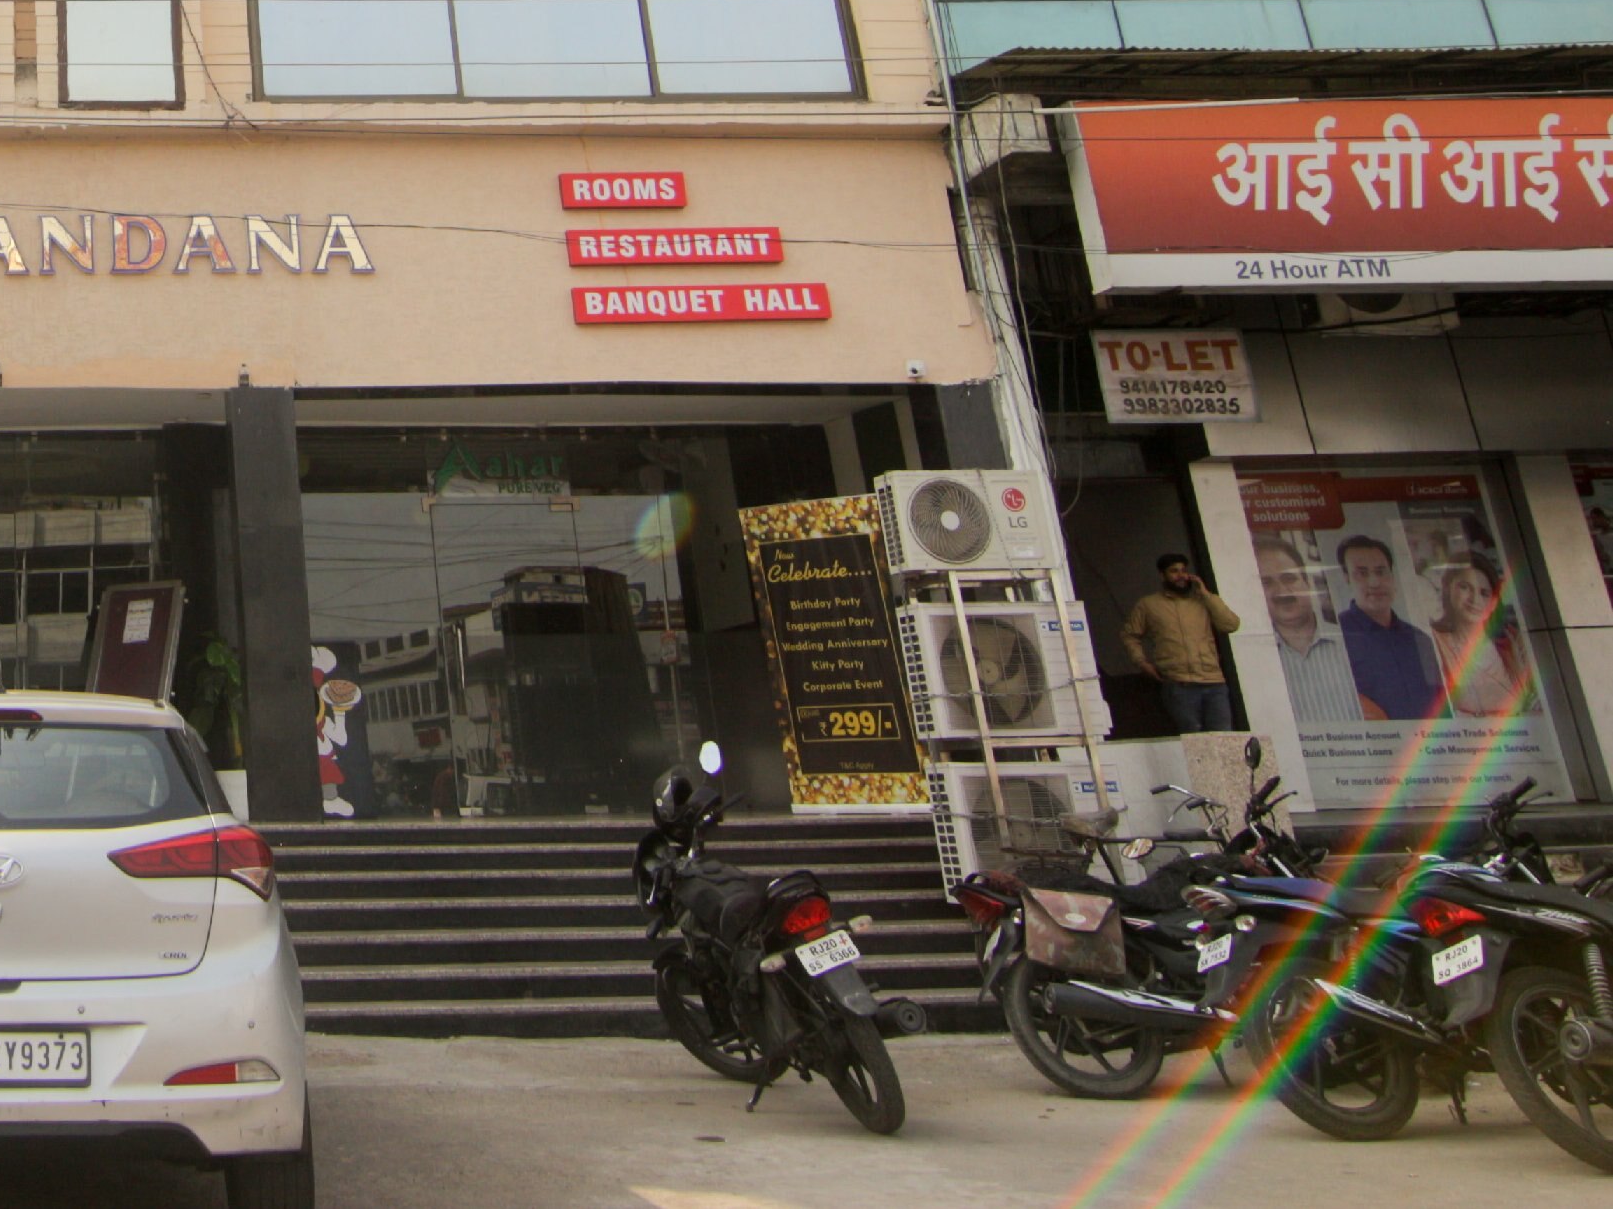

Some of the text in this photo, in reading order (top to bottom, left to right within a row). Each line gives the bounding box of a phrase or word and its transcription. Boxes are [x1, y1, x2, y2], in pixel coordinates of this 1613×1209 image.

[1212, 115, 1337, 226] आई
[1348, 113, 1430, 210] सी
[1440, 113, 1562, 224] आई
[572, 178, 676, 201] ROOMS
[579, 233, 771, 259] RESTAURANT
[1236, 258, 1391, 280] 24 Hour ATM
[584, 288, 819, 316] BANQUET HALL
[1098, 339, 1238, 371] TO-LET
[1120, 380, 1226, 395] 9414178420
[1123, 398, 1240, 415] 9983302835
[498, 482, 562, 494] PURE VEG
[1255, 496, 1326, 508] customised
[1009, 517, 1028, 528] LG
[1252, 510, 1310, 522] solutions
[790, 596, 861, 611] Birthday Party
[785, 616, 875, 632] Engagement Party
[781, 638, 888, 652] Wedding Anniversary
[812, 659, 864, 672] Kitty Party
[803, 679, 883, 693] Corporate Event
[1326, 732, 1363, 741] Business
[1365, 731, 1401, 740] Account
[1421, 728, 1529, 738] Extensive Trade Solutions
[1302, 747, 1393, 758] Quick Business Loans
[1425, 744, 1540, 756] Cash Management Services
[1336, 777, 1349, 786] For
[1351, 778, 1372, 786] more
[1404, 776, 1430, 787] please
[1432, 775, 1449, 786] step
[1445, 945, 1468, 961] RJ20
